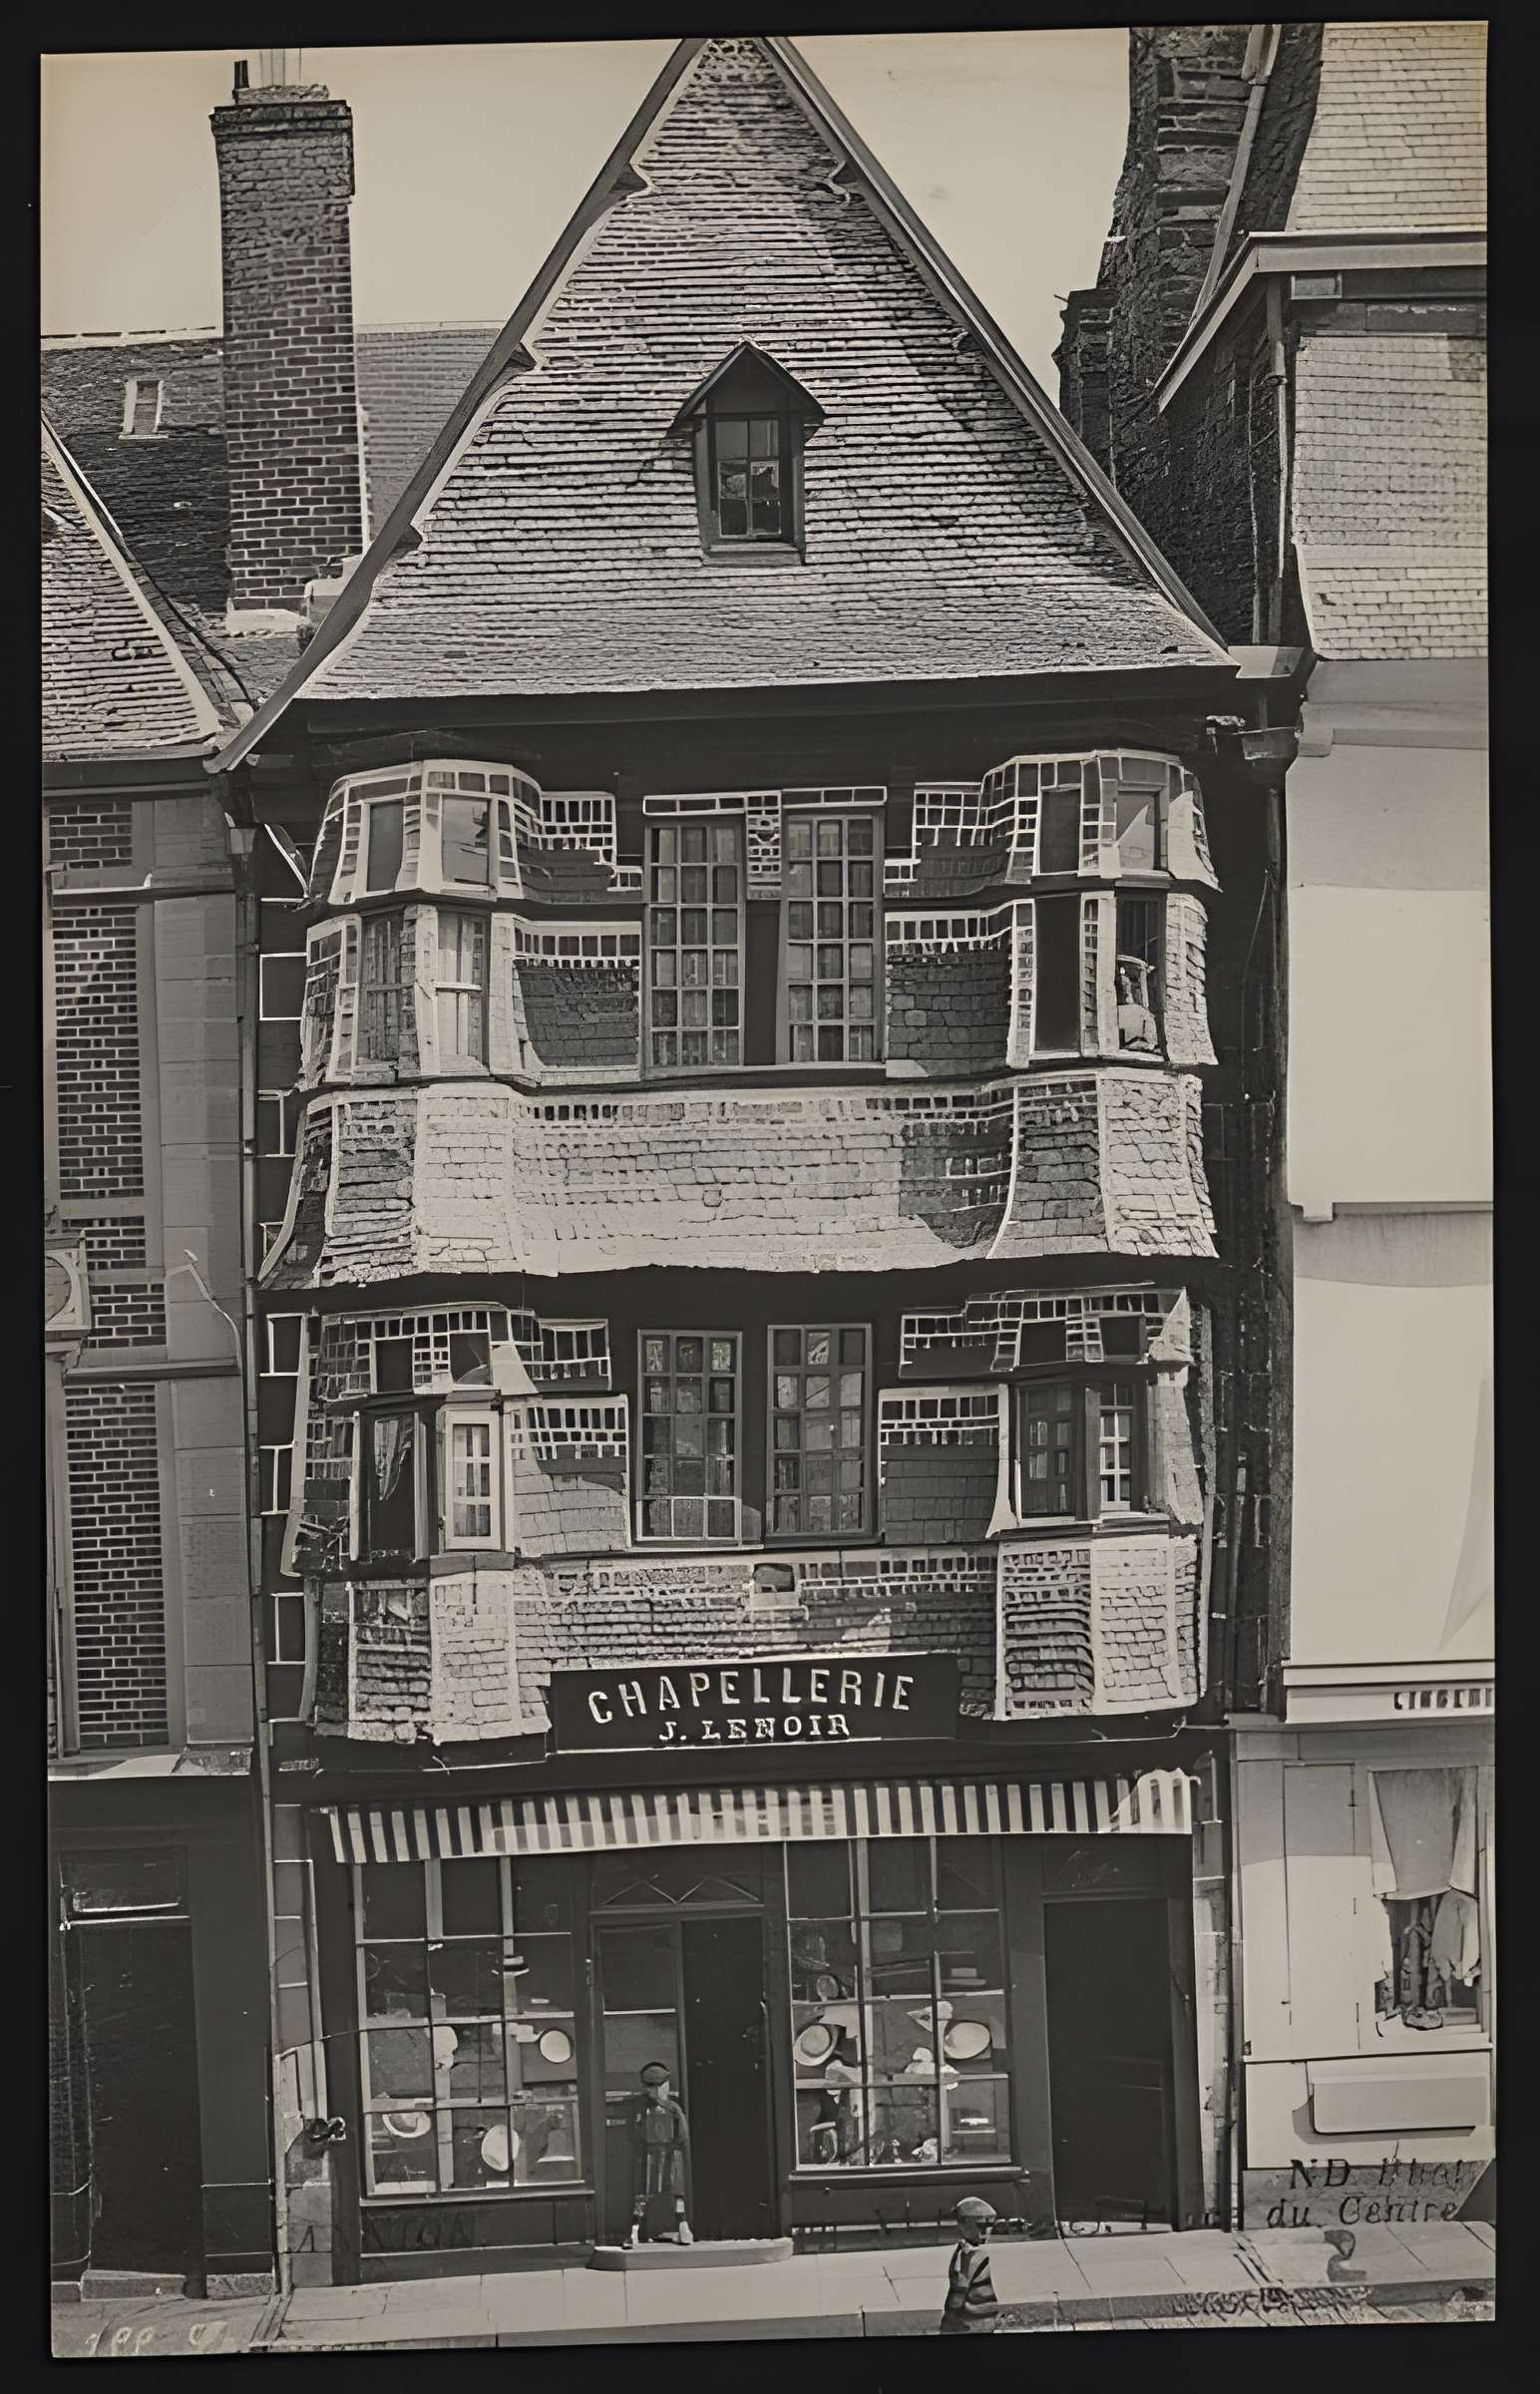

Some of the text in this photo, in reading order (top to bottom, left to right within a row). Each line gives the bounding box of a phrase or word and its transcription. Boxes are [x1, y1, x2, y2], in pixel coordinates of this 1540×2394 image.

[587, 1667, 914, 1724] CHAPELLERIE
[658, 1714, 850, 1741] J. LENOIR
